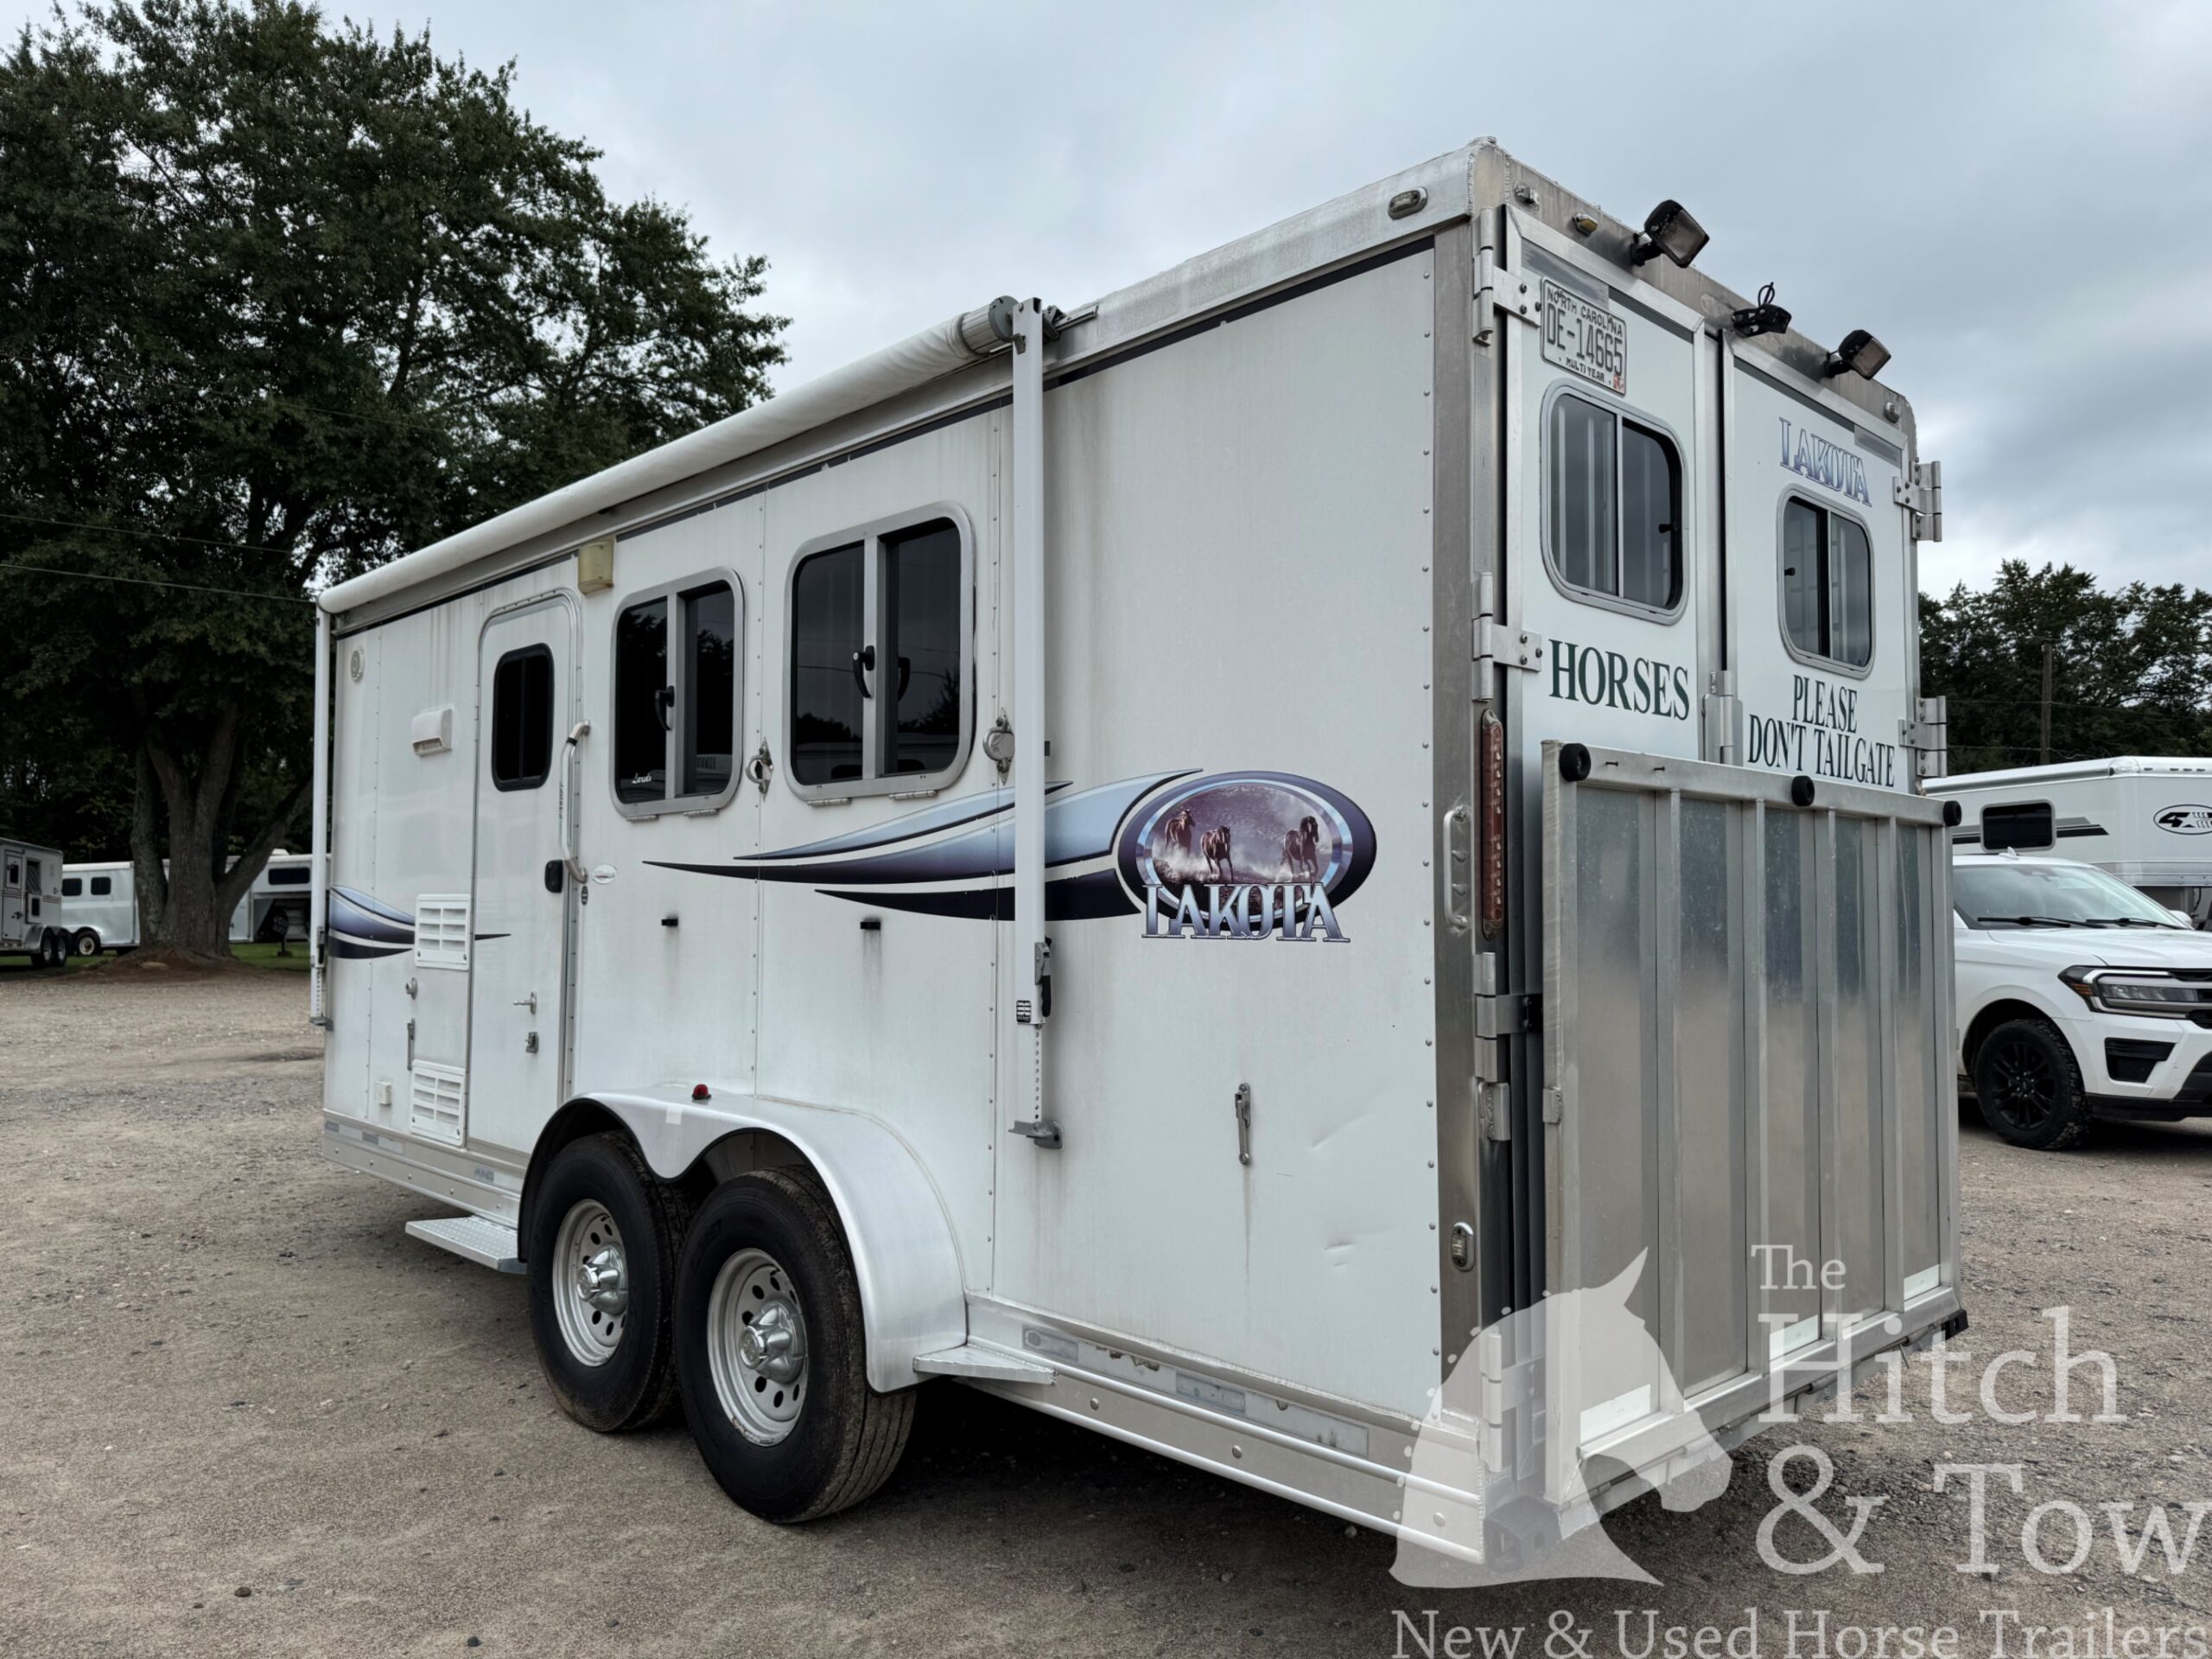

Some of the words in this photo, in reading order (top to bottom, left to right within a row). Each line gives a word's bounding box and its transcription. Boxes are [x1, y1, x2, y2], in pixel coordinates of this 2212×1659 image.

[1547, 287, 1578, 315] NORTH
[1580, 305, 1623, 337] CAROLINA
[1547, 303, 1623, 376] DE-14665
[1566, 358, 1586, 373] MULTI
[1587, 367, 1605, 382] YEAR
[1779, 416, 1872, 507] LAKOTA
[1548, 639, 1690, 721] HORSES
[1792, 674, 1858, 734] PLEASE
[1747, 714, 1807, 772] DON'T
[1814, 729, 1896, 787] TAILGATE
[1141, 881, 1351, 943] LAKOTA
